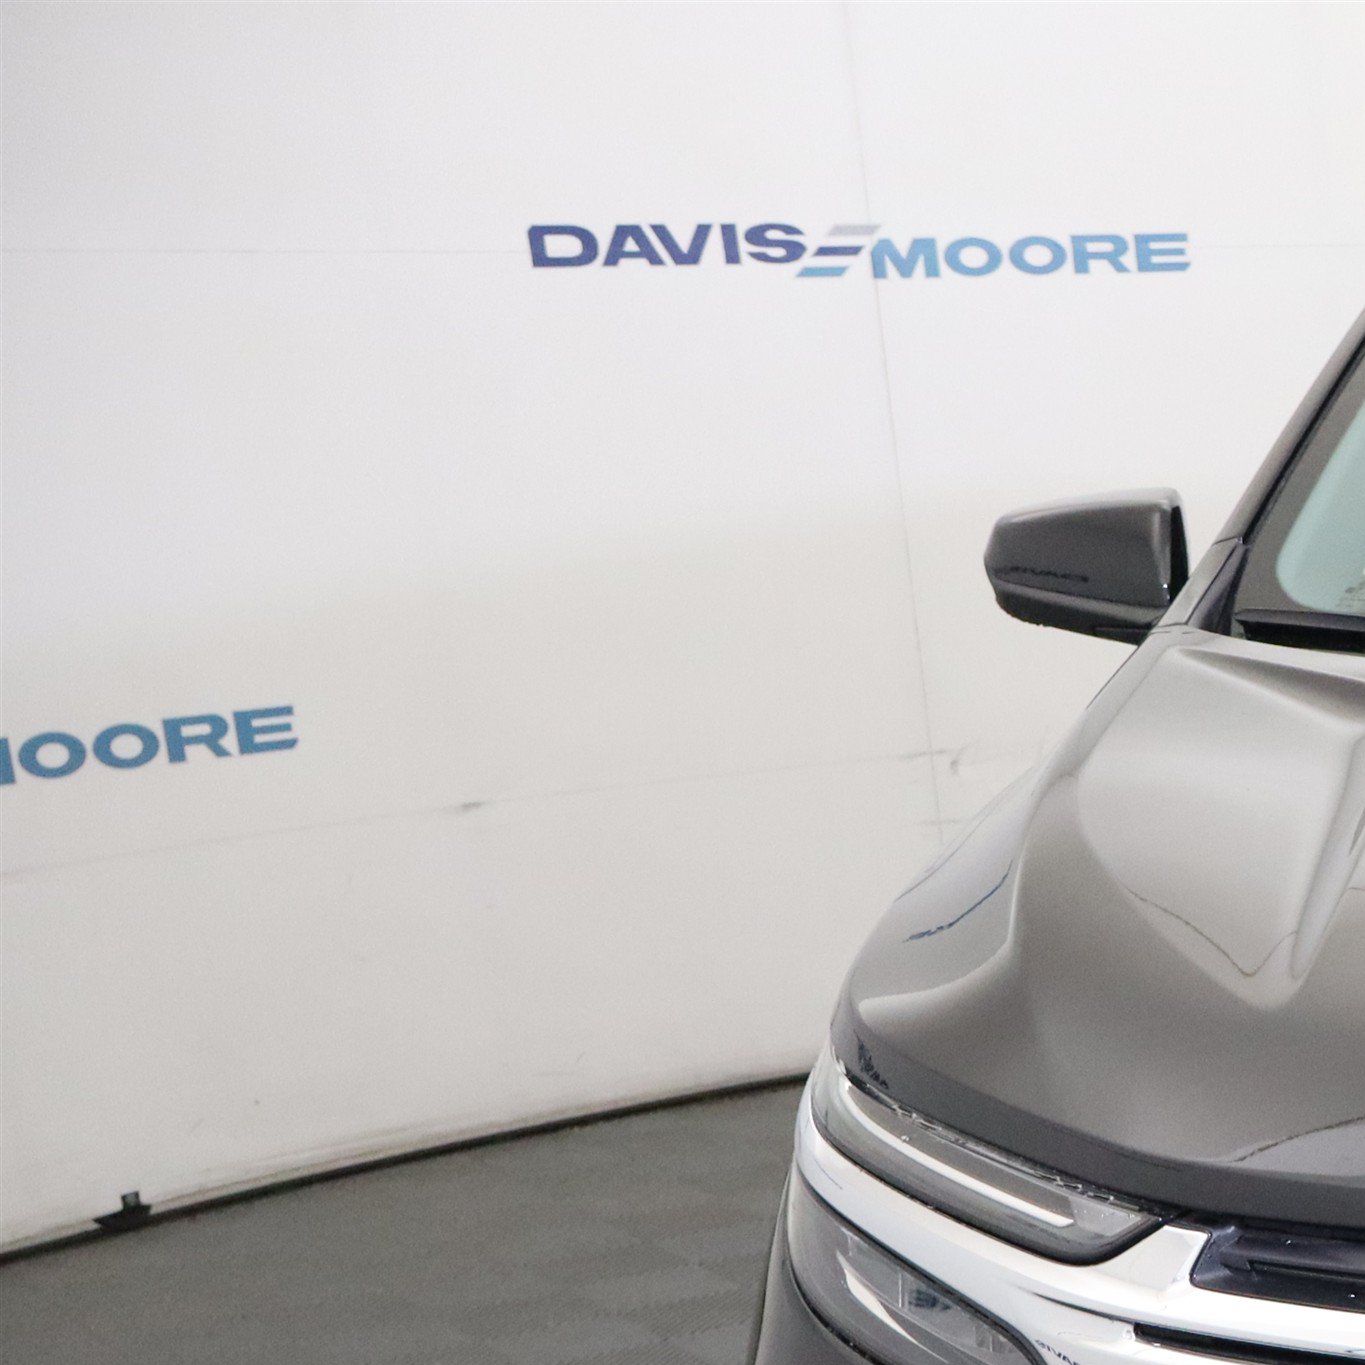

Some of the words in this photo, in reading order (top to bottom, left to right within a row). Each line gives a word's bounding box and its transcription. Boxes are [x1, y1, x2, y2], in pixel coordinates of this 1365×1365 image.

[528, 223, 805, 267] DAVIS
[870, 233, 1191, 279] MOORE
[0, 705, 299, 786] OORE
